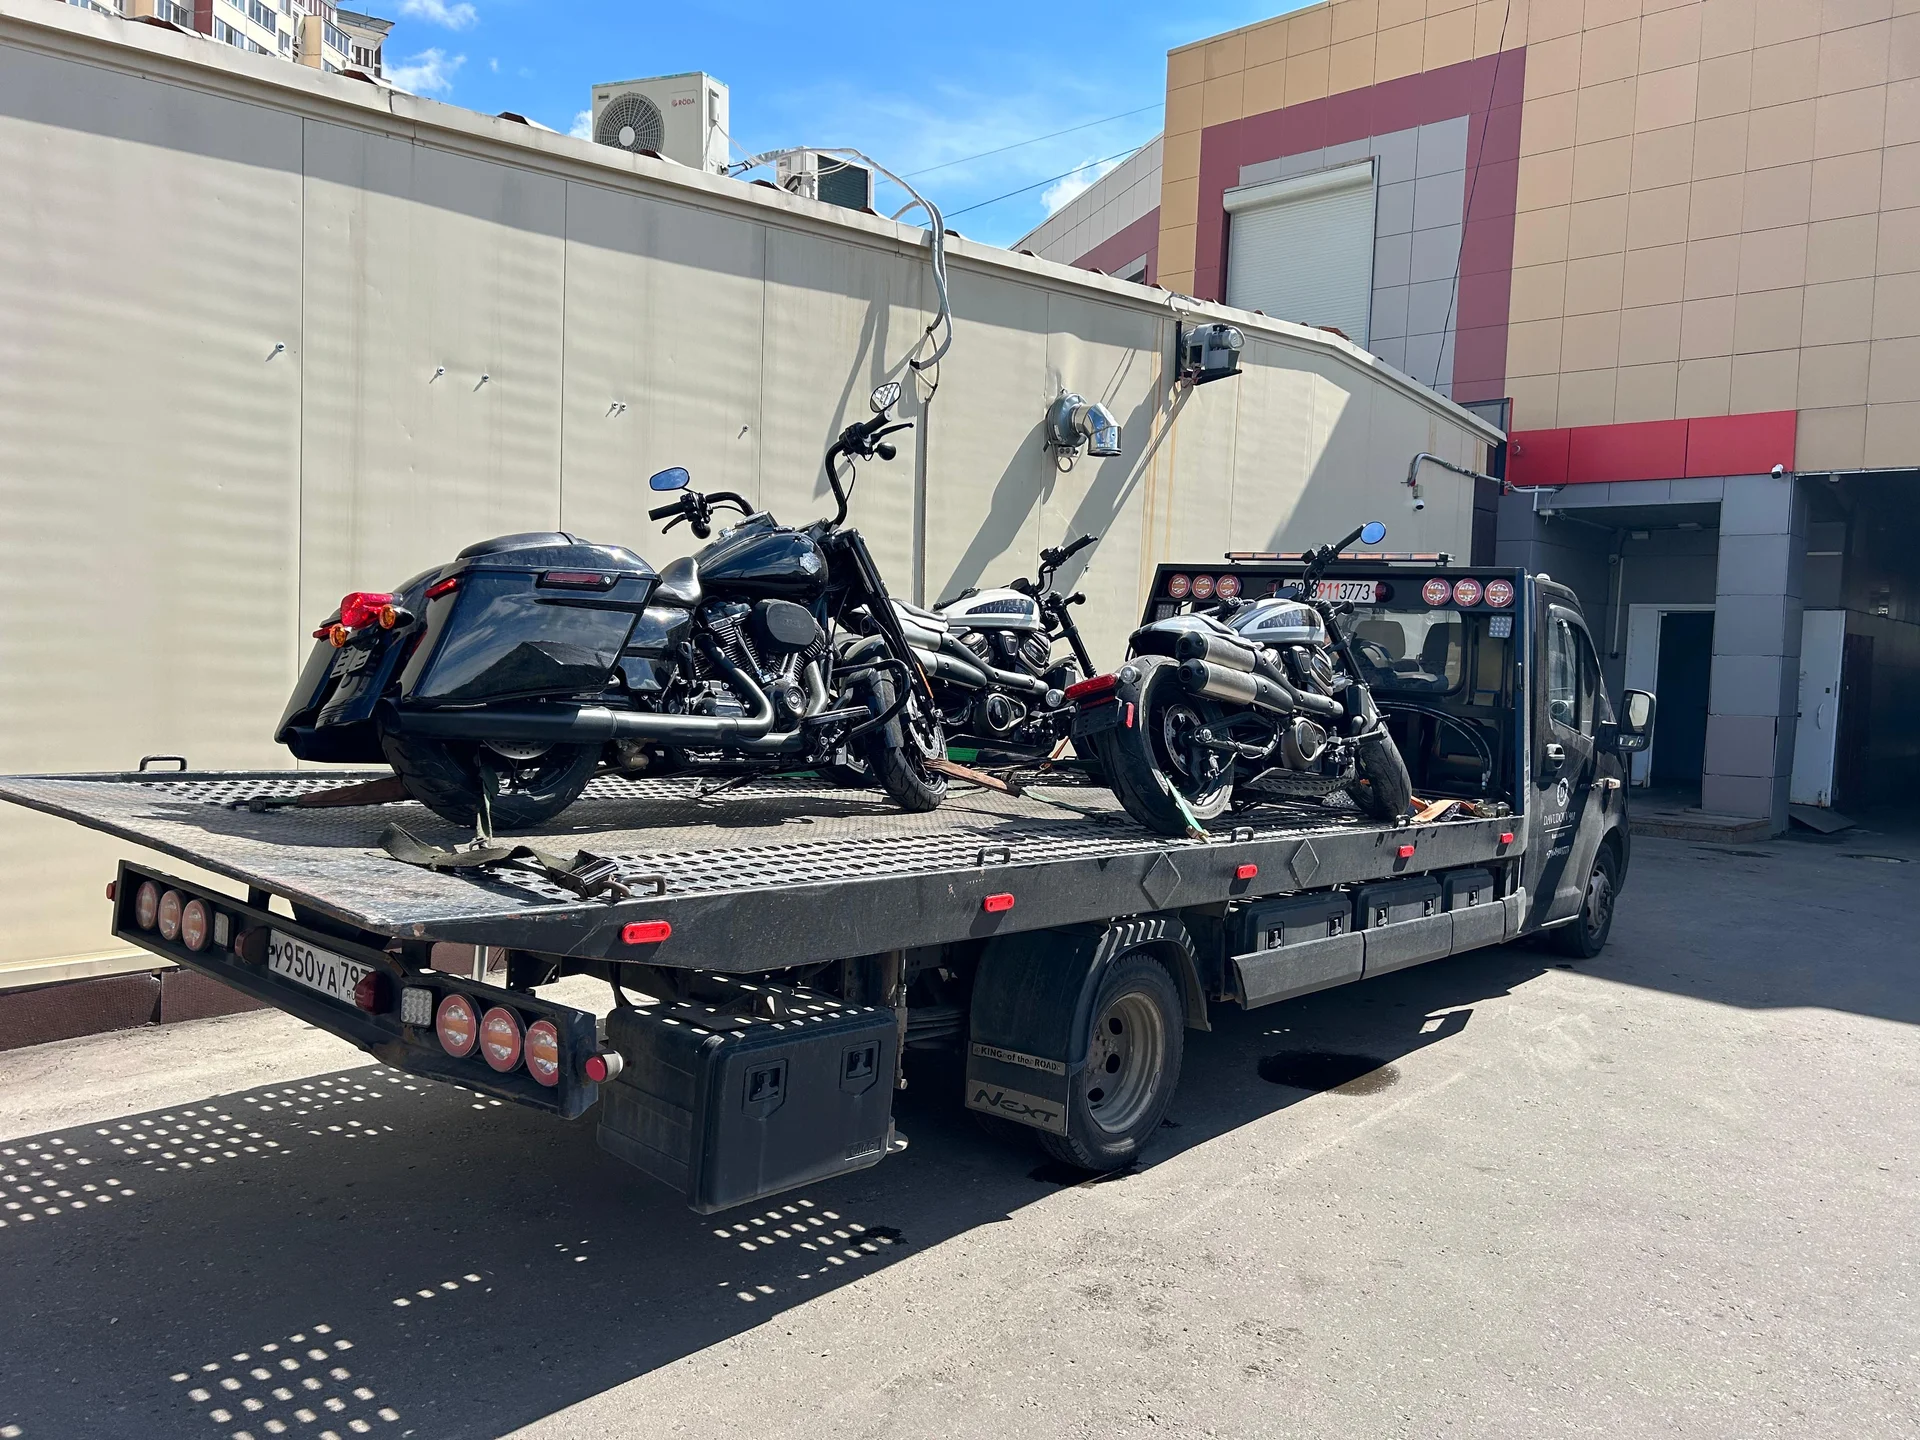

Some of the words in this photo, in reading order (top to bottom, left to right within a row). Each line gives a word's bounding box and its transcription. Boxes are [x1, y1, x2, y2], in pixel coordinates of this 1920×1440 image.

[981, 1046, 1002, 1058] KING
[1007, 1053, 1016, 1062] of
[1017, 1055, 1030, 1065] the
[1034, 1058, 1057, 1071] ROAD
